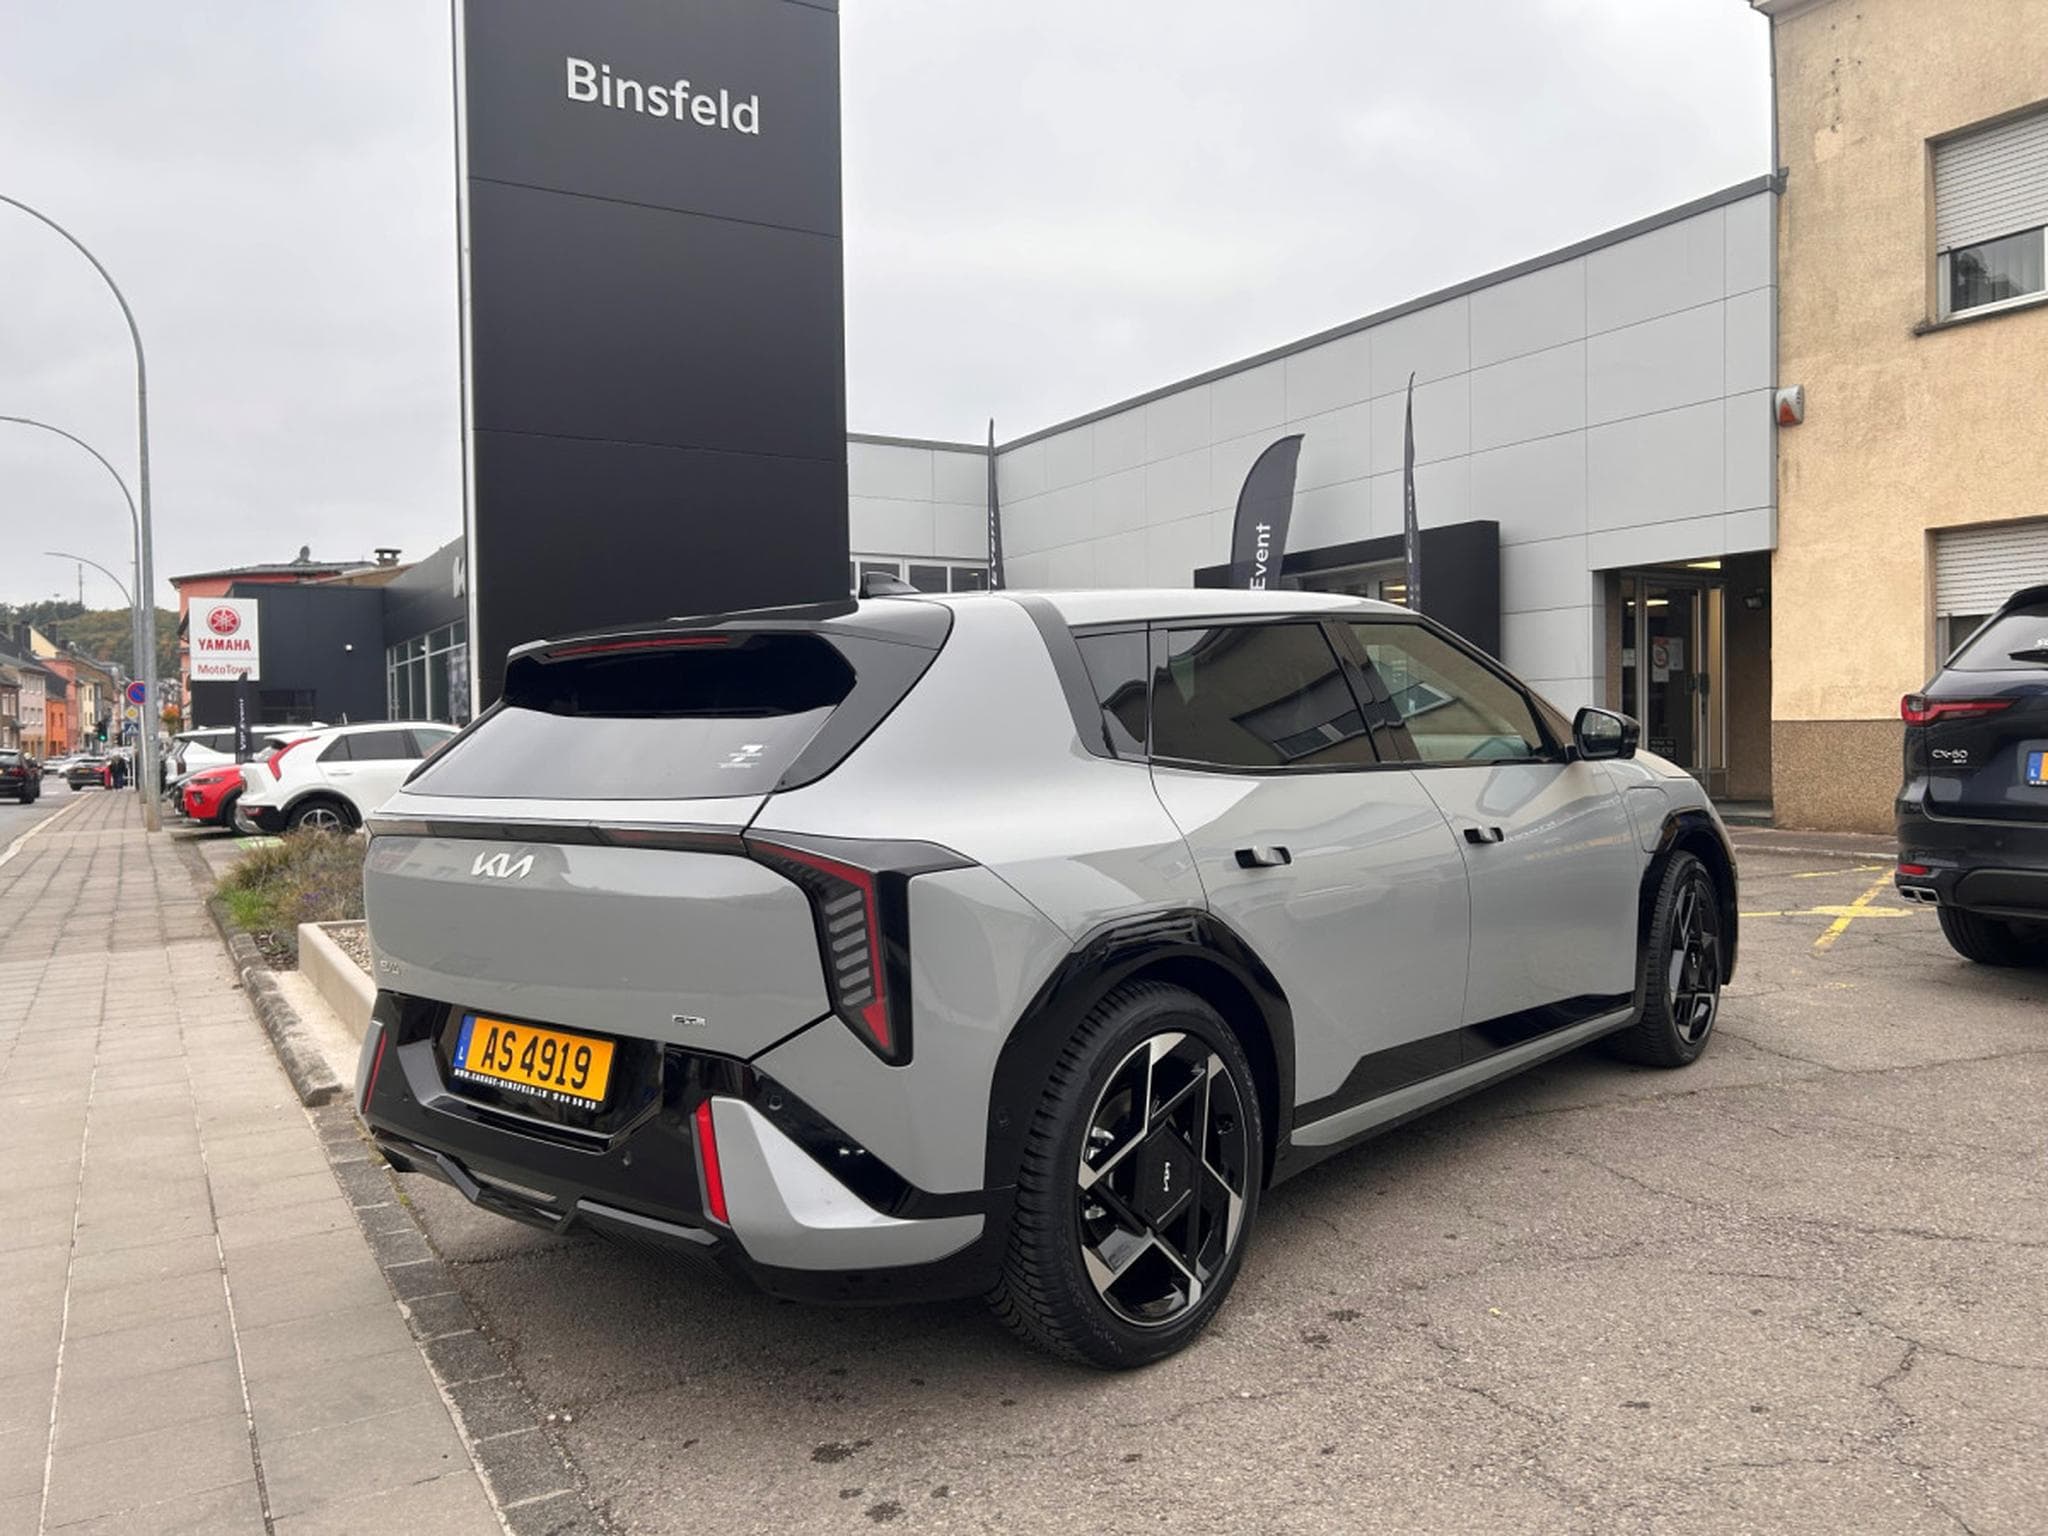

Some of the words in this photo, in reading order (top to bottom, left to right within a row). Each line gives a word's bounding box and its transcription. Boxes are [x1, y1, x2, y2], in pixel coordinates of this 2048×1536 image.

[567, 57, 759, 134] Binsfeld
[1250, 522, 1271, 590] Event
[198, 638, 252, 652] YAMAHA
[198, 664, 252, 675] MotoTown
[1932, 748, 1969, 759] CX-60
[471, 851, 535, 879] KIA
[480, 1027, 517, 1073] AS
[520, 1035, 592, 1090] 4919
